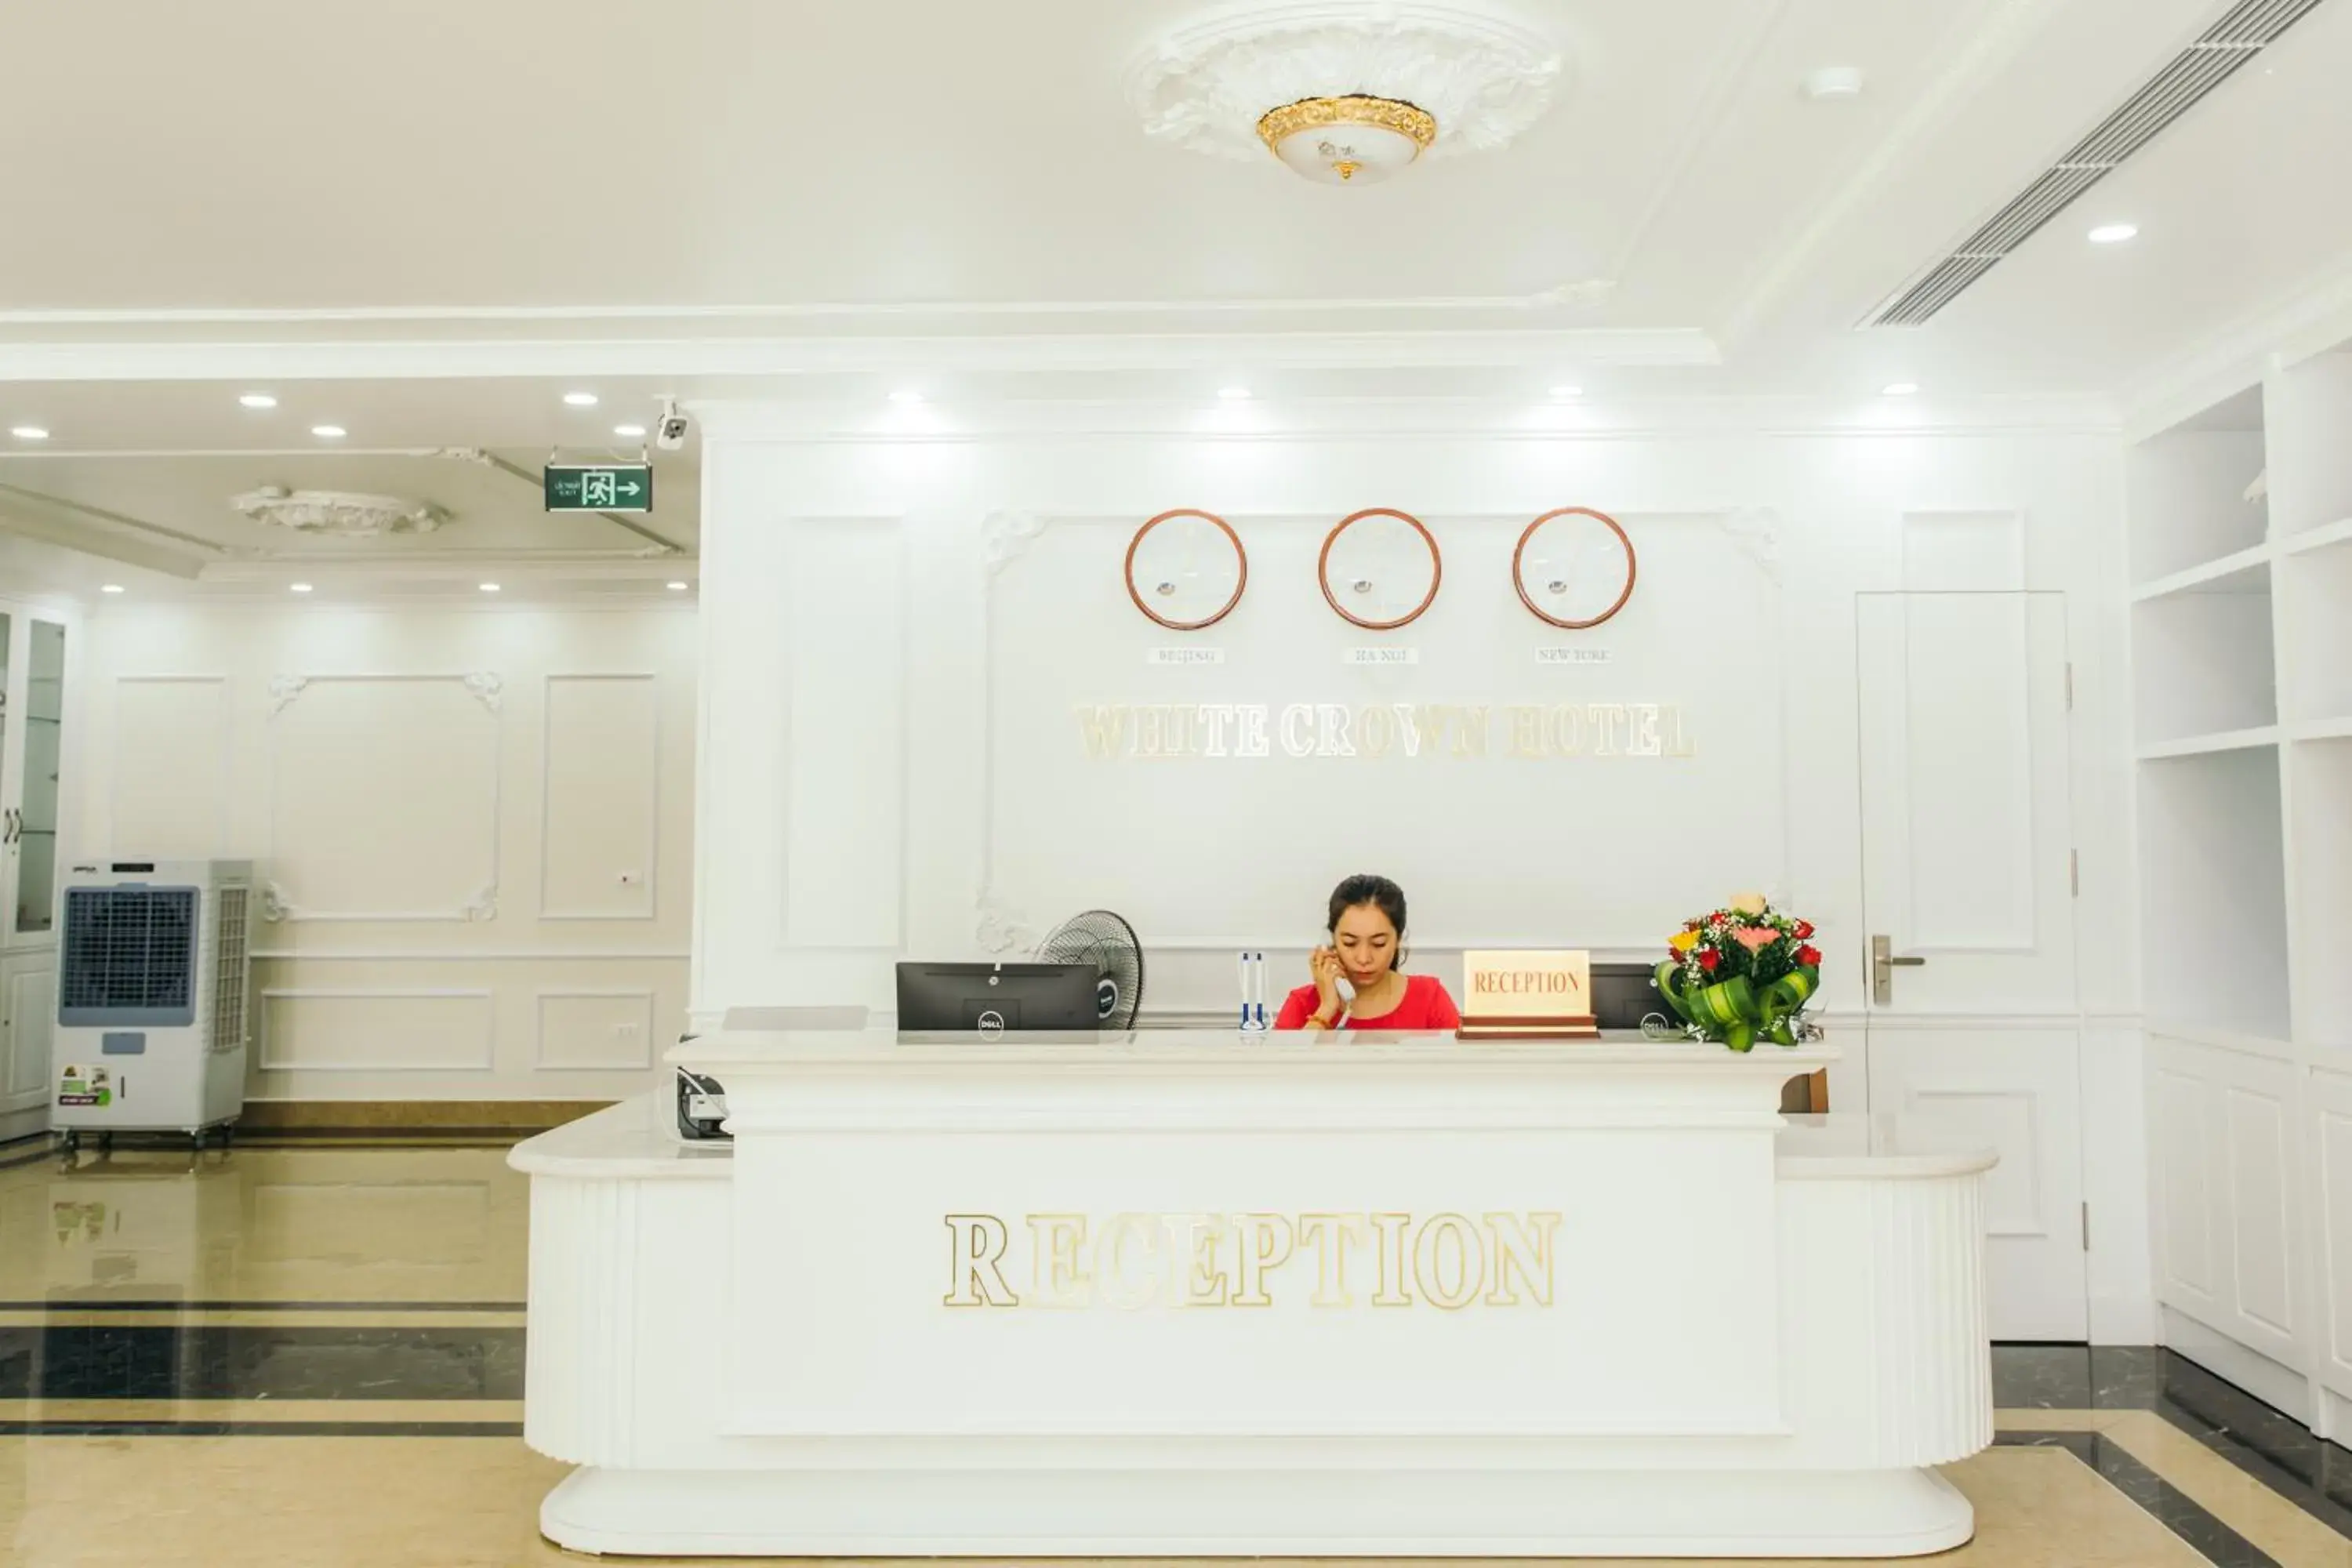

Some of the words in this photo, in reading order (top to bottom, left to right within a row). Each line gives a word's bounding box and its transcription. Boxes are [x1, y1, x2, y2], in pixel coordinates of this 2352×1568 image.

[1539, 648, 1571, 661] NEW
[1573, 649, 1613, 662] YORK
[1075, 702, 1271, 759] WHITE
[1279, 702, 1490, 759] CROWN
[1504, 702, 1698, 759] HOTEL
[1474, 971, 1580, 994] RECEPTION
[981, 1019, 1001, 1029] DELL
[943, 1212, 1563, 1310] RECEPTION
